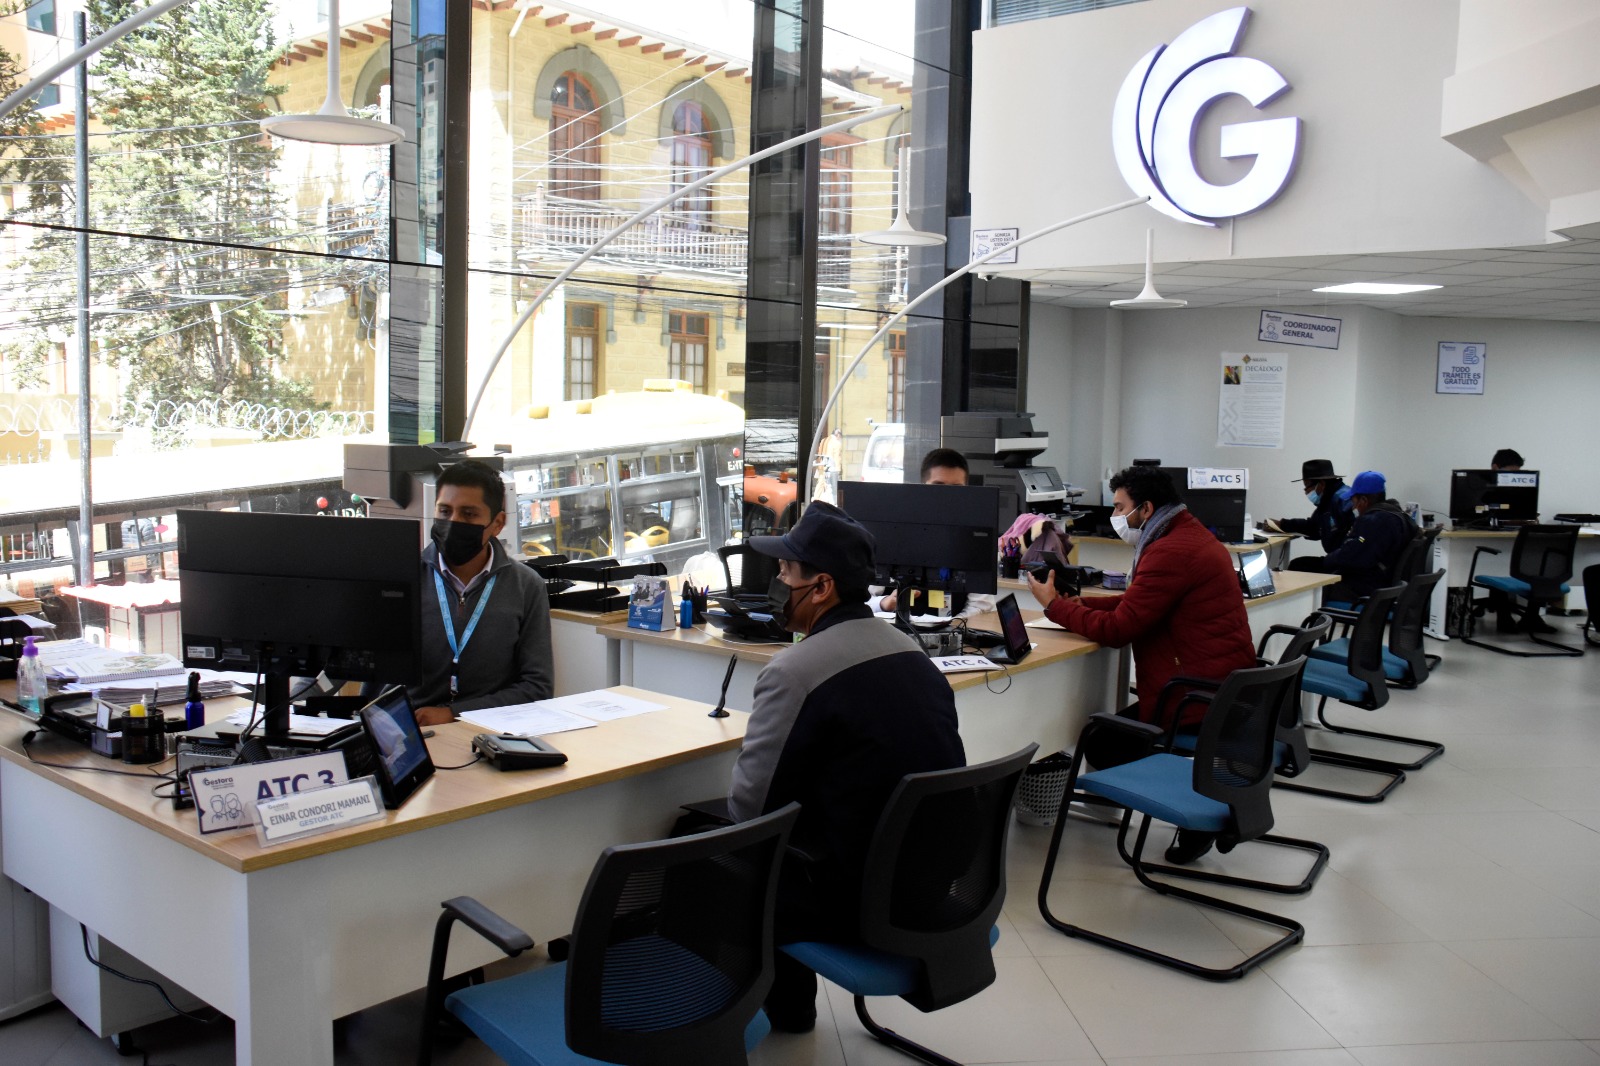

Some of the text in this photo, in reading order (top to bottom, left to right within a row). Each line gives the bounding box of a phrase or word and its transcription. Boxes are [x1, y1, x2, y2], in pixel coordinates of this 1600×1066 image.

[1283, 320, 1337, 333] COORDINADOR
[1282, 329, 1315, 339] GENERAL
[1443, 378, 1479, 386] GRATUITO
[1210, 474, 1241, 484] ATC 5
[941, 659, 975, 667] ATC
[202, 777, 234, 786] Gestora
[257, 773, 310, 800] ATC
[269, 811, 297, 826] EINAR
[297, 801, 336, 819] CONDORI
[338, 794, 371, 811] MAMANI
[298, 811, 344, 828] GESTOR ATC
